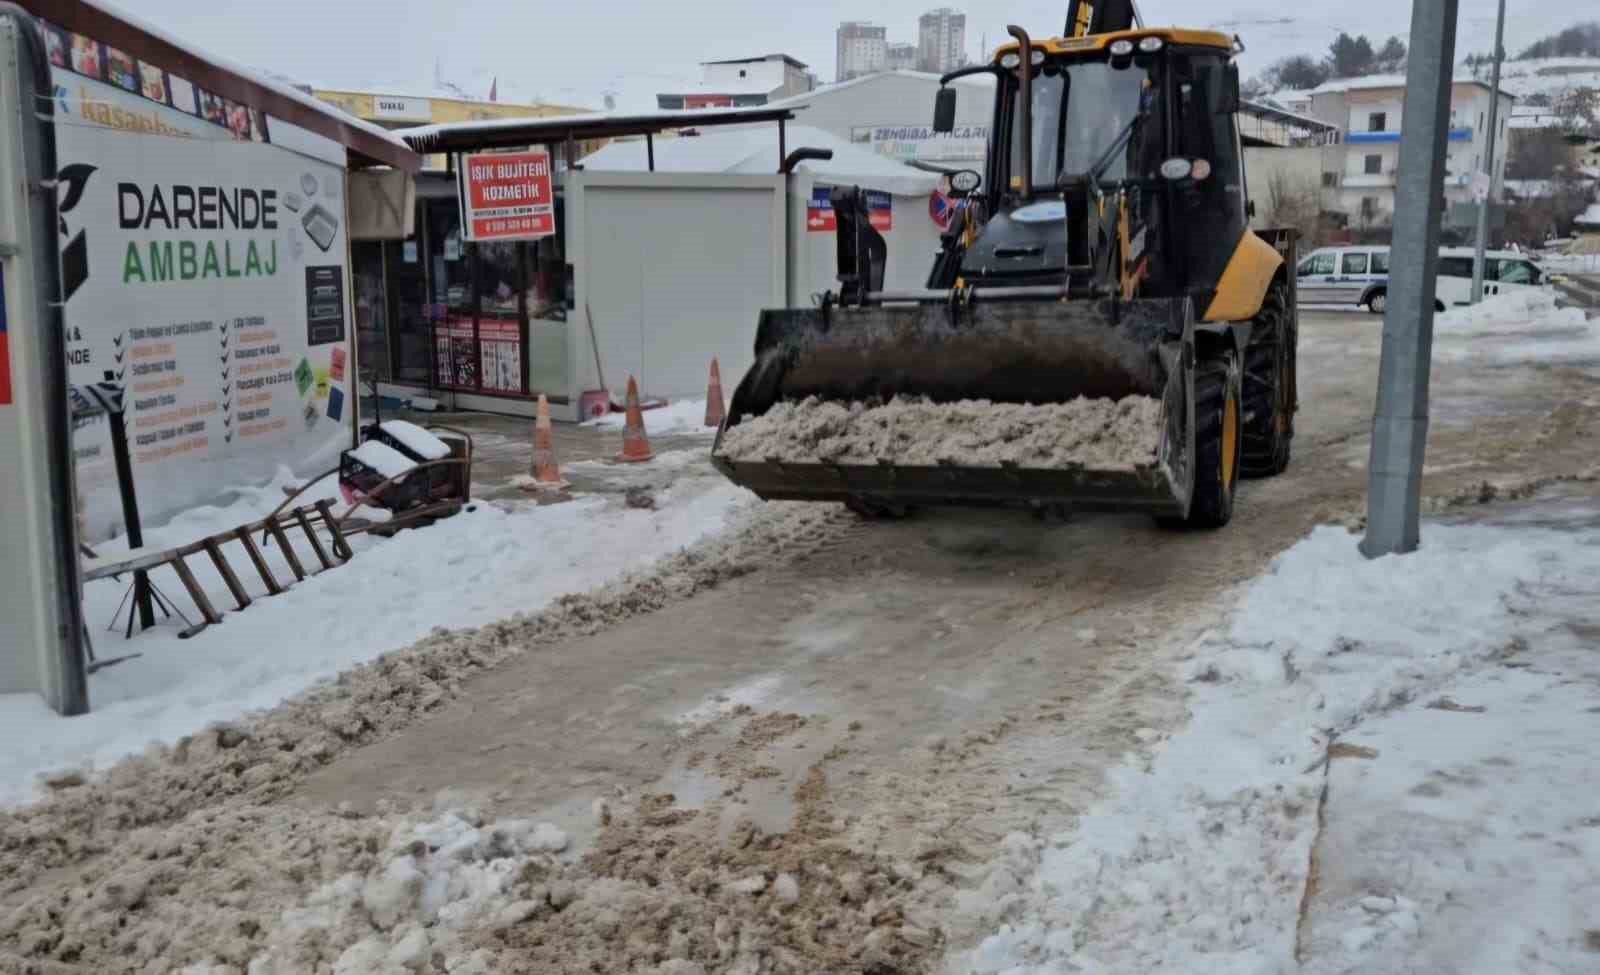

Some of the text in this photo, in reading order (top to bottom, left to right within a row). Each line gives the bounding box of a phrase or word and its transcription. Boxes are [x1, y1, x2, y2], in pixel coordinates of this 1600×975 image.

[118, 183, 278, 229] DARENDE
[483, 180, 540, 201] KOZMETİK
[124, 240, 277, 284] AMBALAJ
